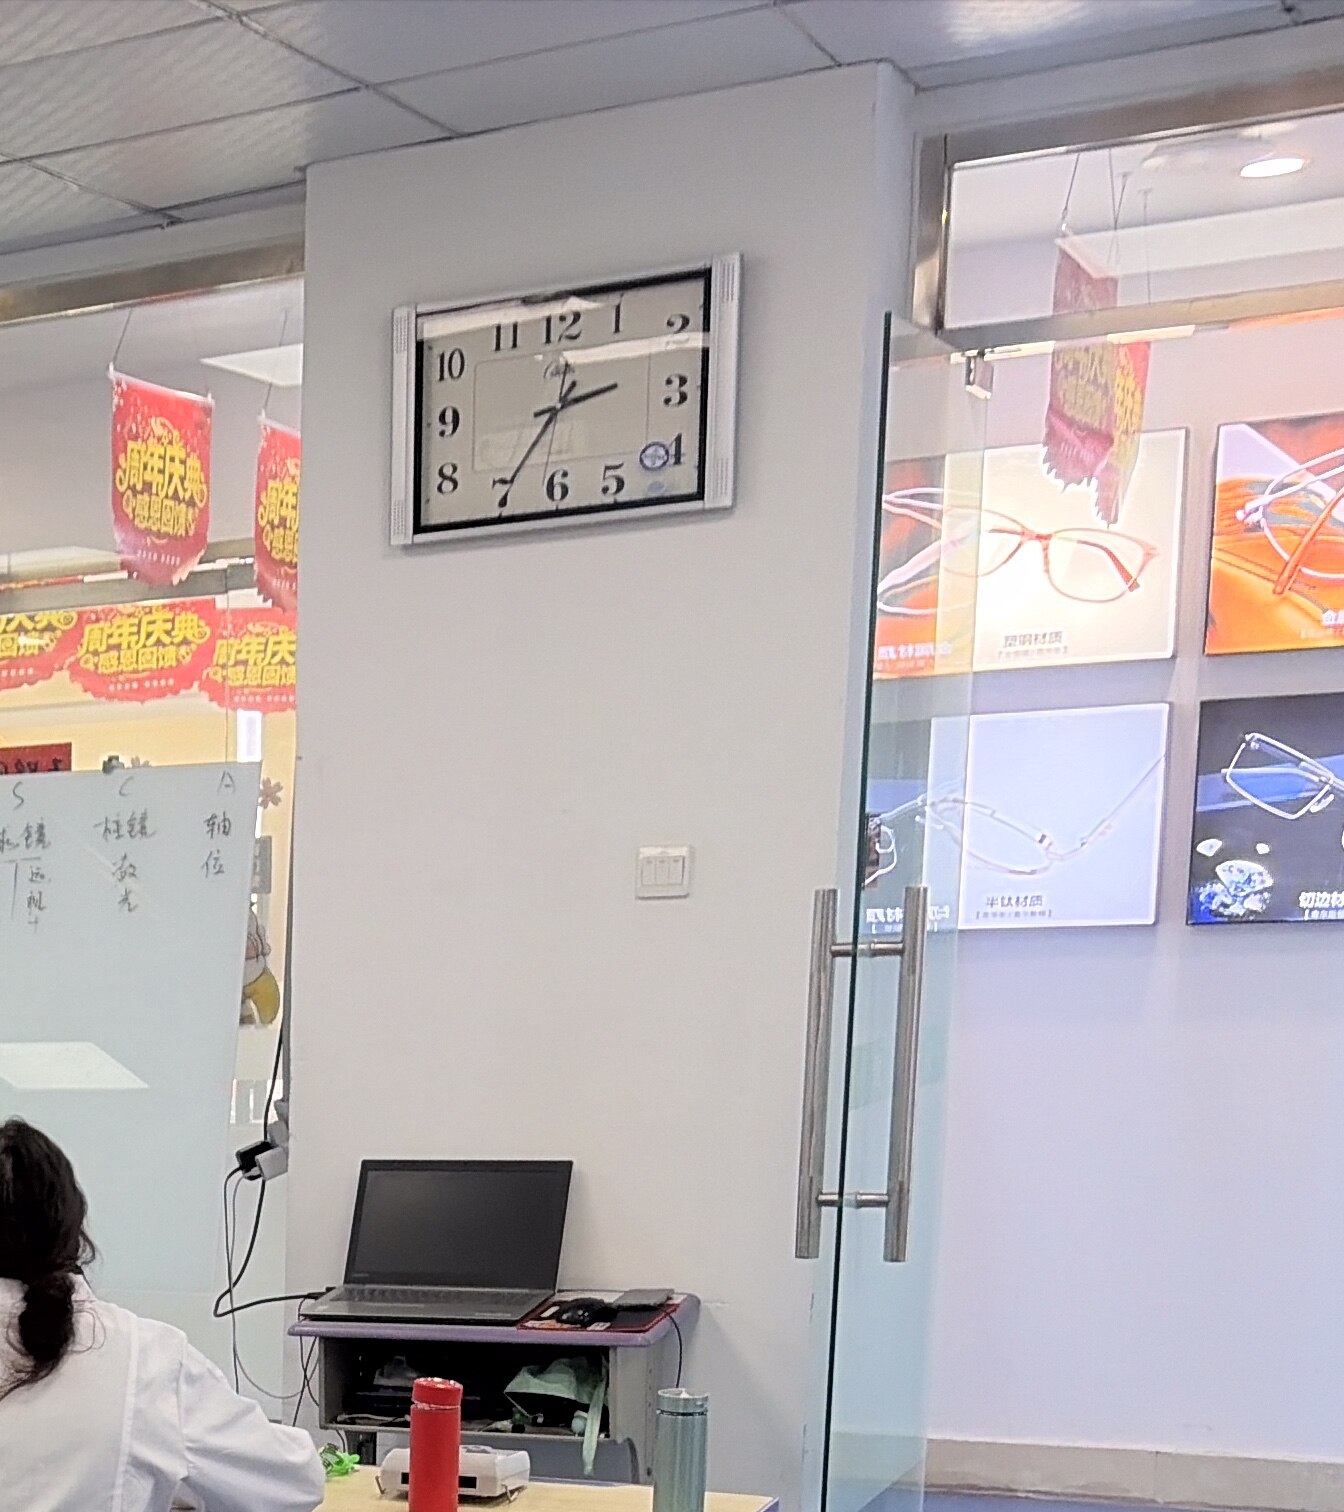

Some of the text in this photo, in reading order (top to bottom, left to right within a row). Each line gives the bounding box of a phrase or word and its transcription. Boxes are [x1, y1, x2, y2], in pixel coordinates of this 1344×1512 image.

[543, 309, 582, 346] 12
[612, 294, 624, 333] 1
[494, 321, 518, 351] 11
[666, 312, 690, 351] 2
[438, 348, 465, 382] 10
[663, 373, 689, 407] 3
[438, 406, 460, 437] 9
[665, 433, 683, 465] 4
[118, 440, 206, 502] 周年庆典
[437, 463, 459, 494] 8
[546, 469, 569, 502] 6
[601, 463, 625, 496] 5
[258, 478, 298, 530] 周年
[492, 477, 512, 508] 7
[134, 494, 189, 537] 感恩回馈
[79, 610, 209, 654] 周年庆典
[1003, 631, 1063, 648] 塑钢材质
[98, 645, 179, 673] 感恩回馈
[12, 781, 25, 810] S
[119, 775, 134, 797] C
[217, 770, 236, 794] A
[93, 808, 158, 842] 柱镜
[201, 811, 232, 879] 轴位
